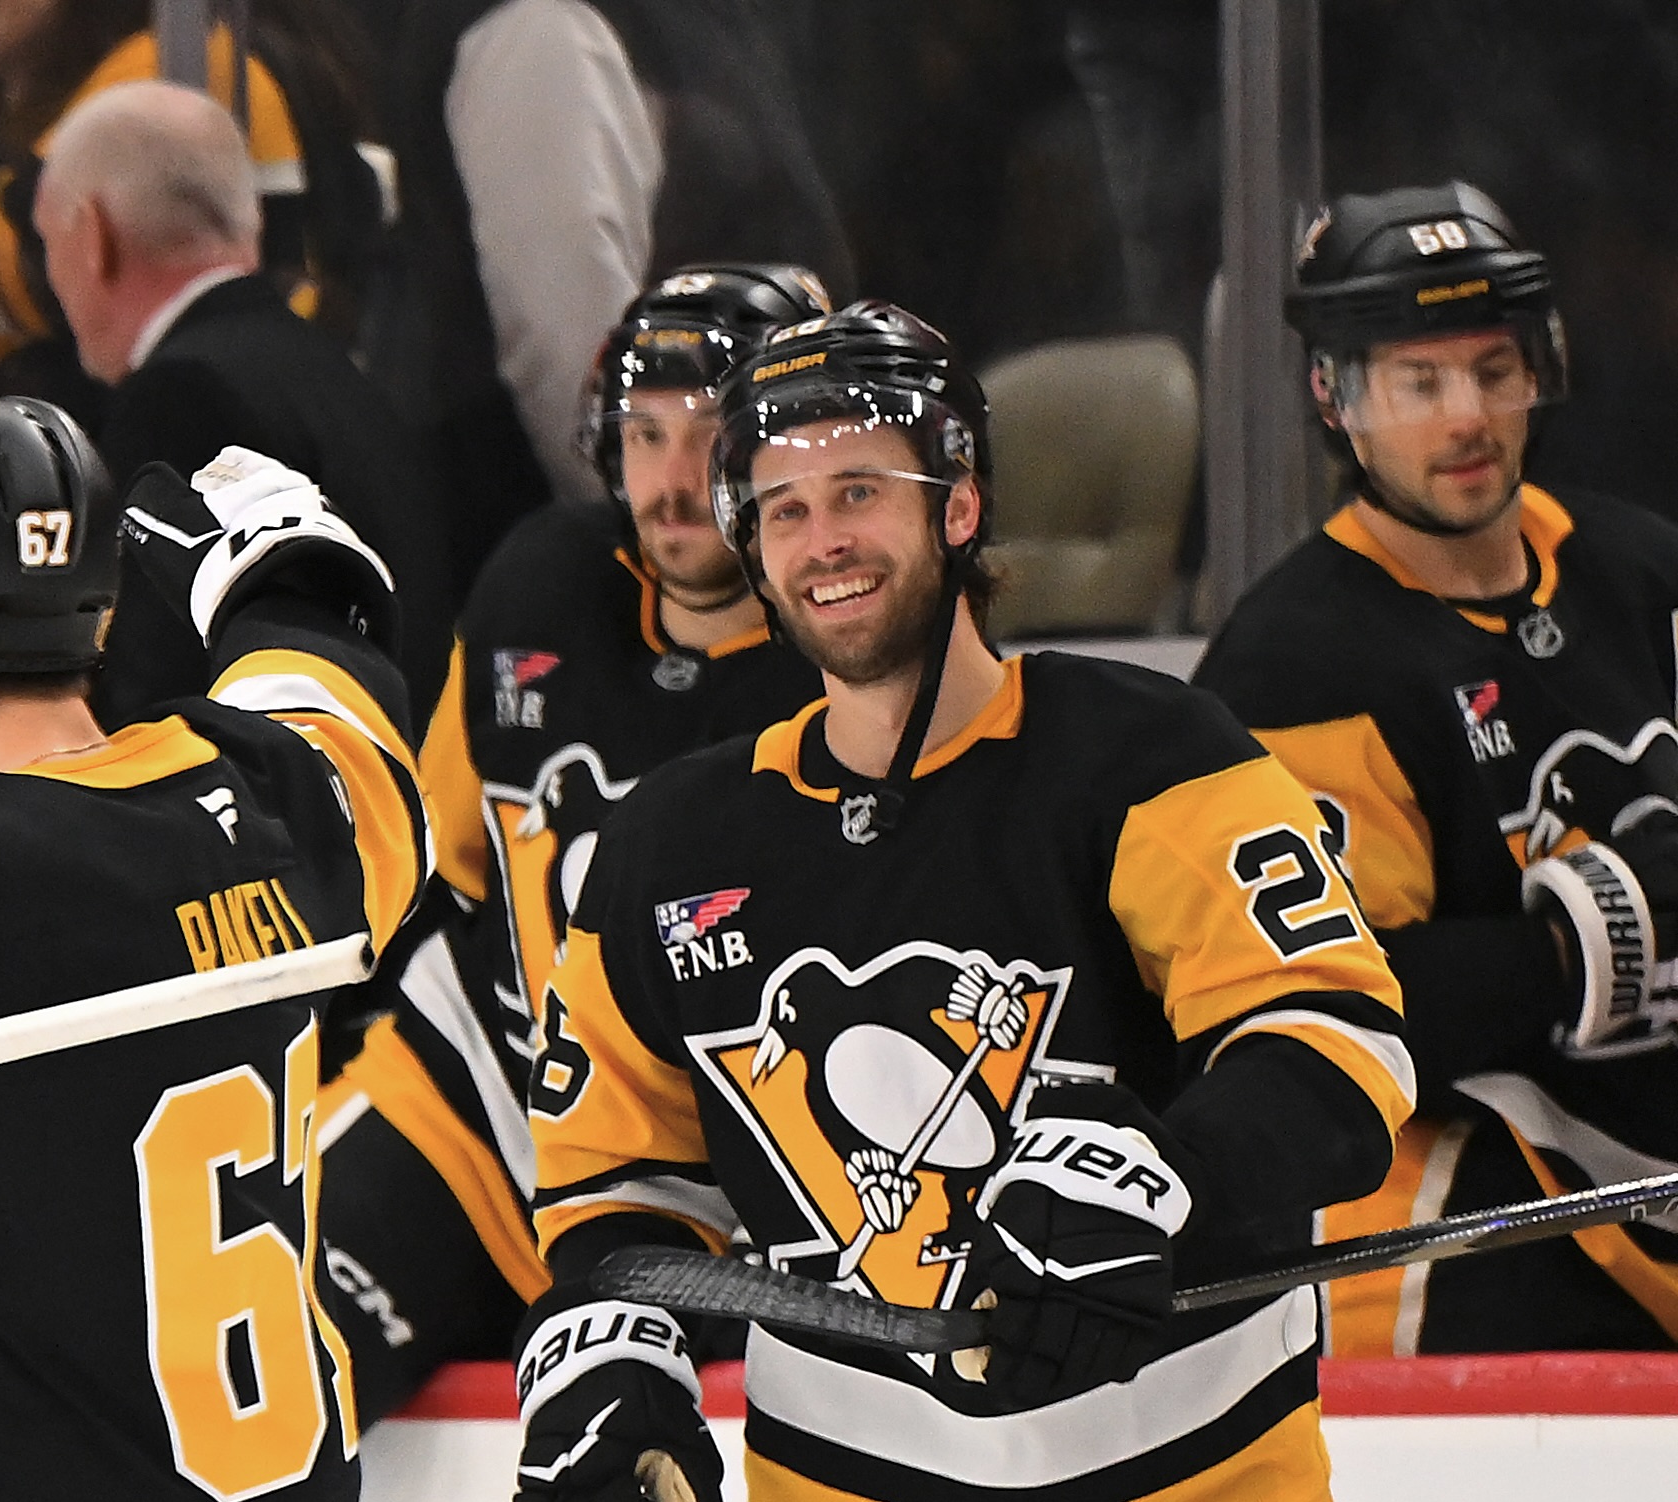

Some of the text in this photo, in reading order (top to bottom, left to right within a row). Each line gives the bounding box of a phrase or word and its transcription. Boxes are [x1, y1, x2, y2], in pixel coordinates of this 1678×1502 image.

[15, 510, 73, 567] 67
[666, 930, 754, 982] F.N.B.
[1015, 1131, 1171, 1212] UER
